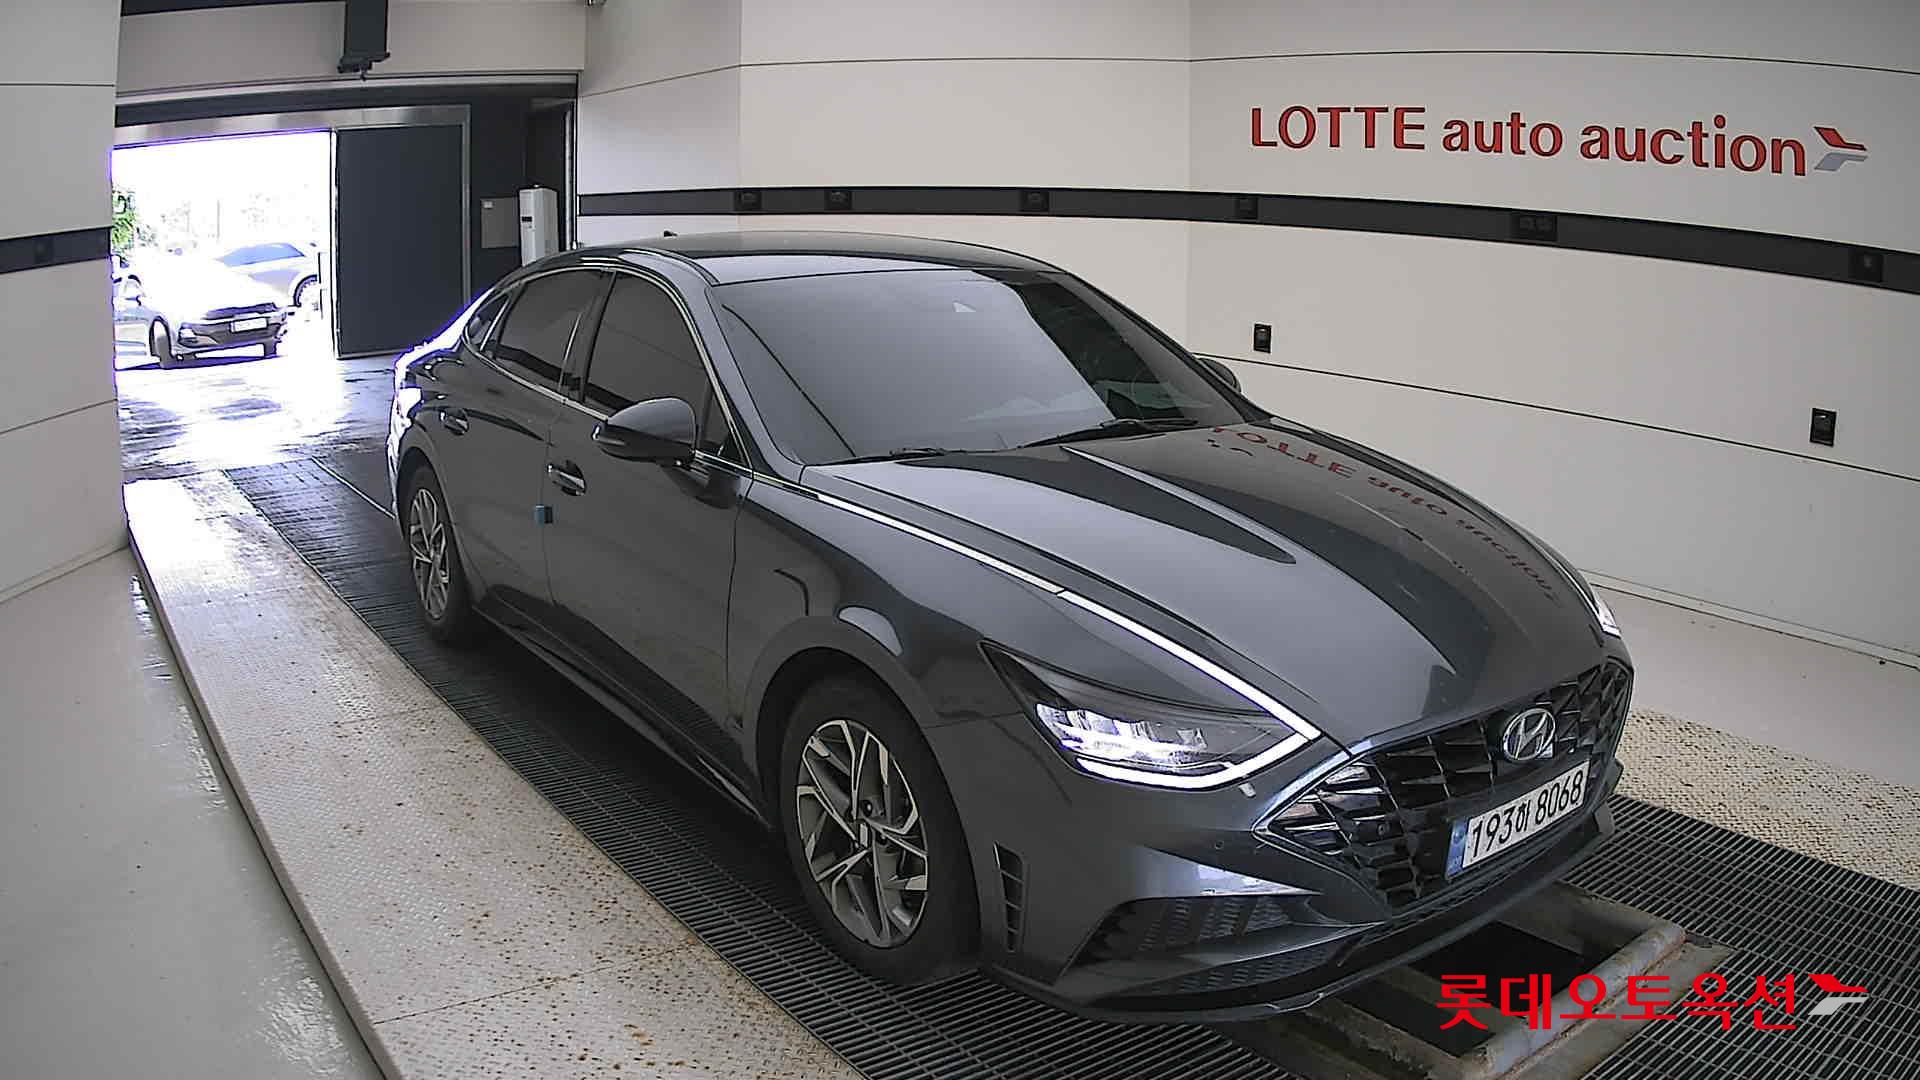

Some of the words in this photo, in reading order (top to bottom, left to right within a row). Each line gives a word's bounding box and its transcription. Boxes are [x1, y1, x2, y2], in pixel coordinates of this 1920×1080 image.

[1251, 106, 1425, 150] LOTTE
[1442, 112, 1563, 157] auto
[1580, 115, 1806, 176] auction
[1535, 769, 1584, 825] 8068
